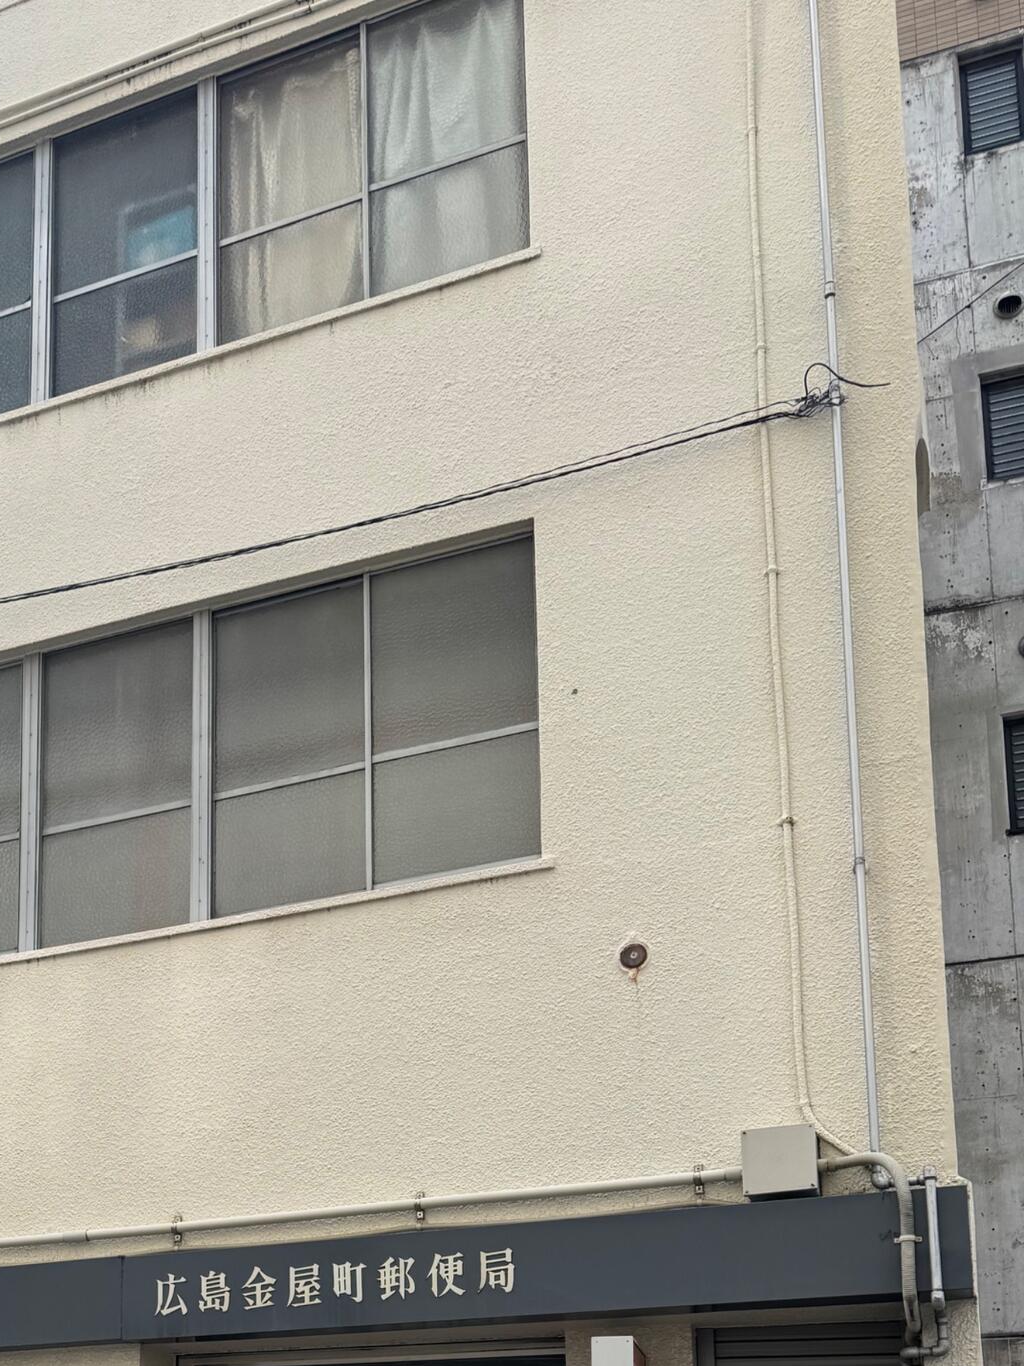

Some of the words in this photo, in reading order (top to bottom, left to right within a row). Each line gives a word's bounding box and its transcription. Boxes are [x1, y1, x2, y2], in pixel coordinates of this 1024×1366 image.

[155, 1248, 516, 1317] 広島金屋町郵便局
